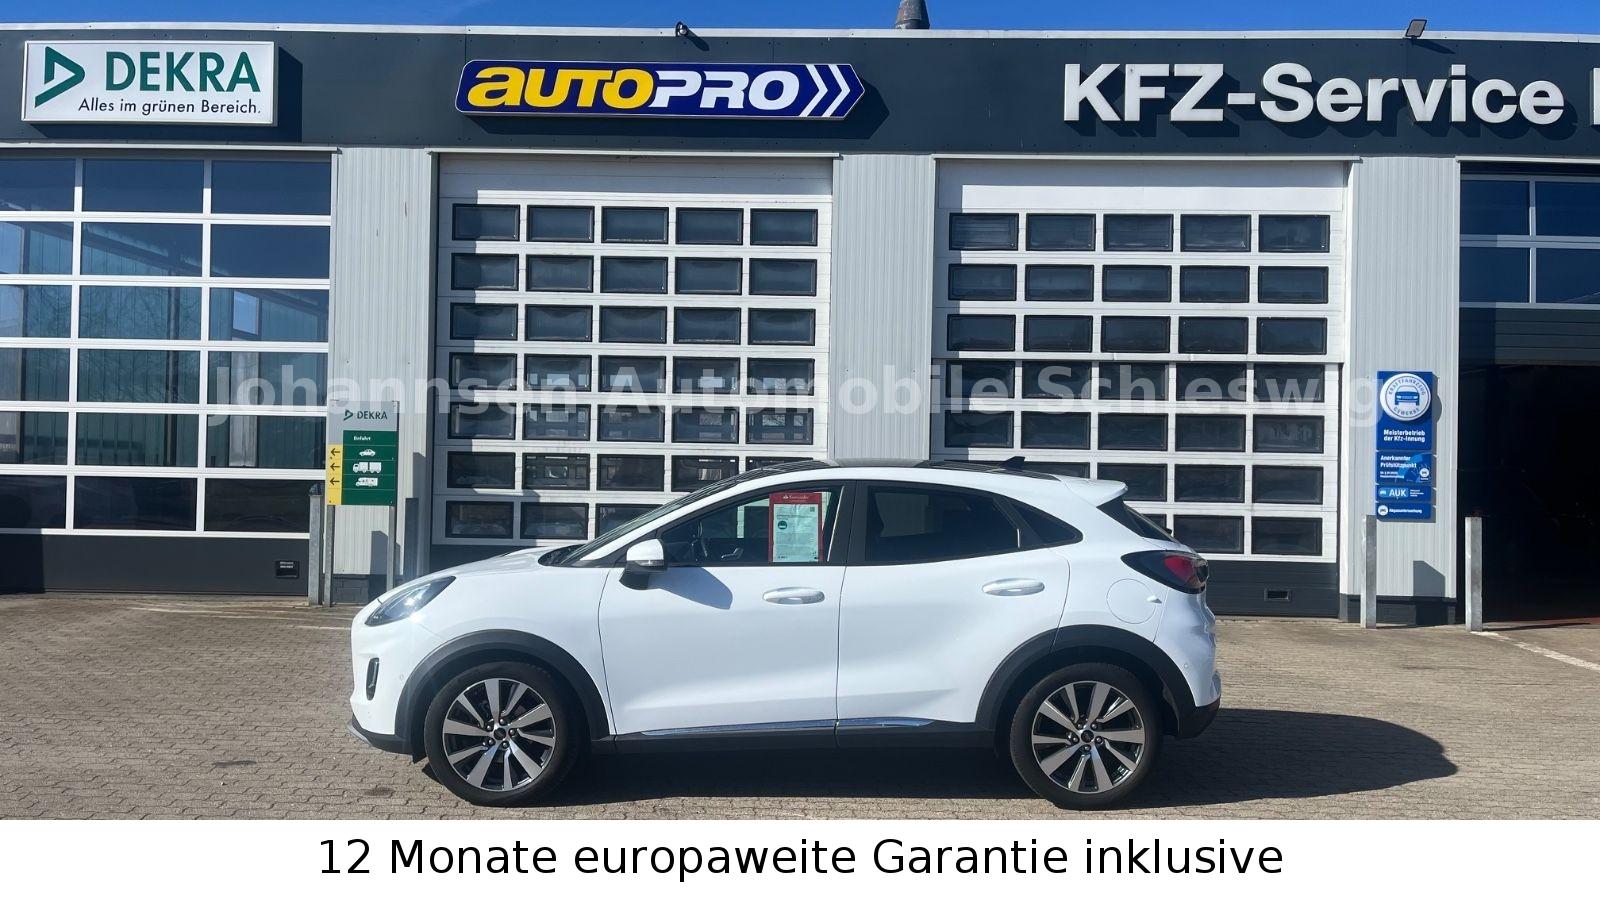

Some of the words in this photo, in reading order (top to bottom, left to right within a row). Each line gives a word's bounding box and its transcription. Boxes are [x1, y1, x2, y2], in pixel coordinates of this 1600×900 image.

[105, 51, 261, 93] DEKRA
[1063, 62, 1565, 125] KFZ-Service
[78, 97, 115, 112] Alles
[119, 97, 137, 112] im
[142, 98, 195, 116] grünen
[201, 98, 262, 114] Bereich.
[356, 410, 388, 420] DEKRA
[1389, 488, 1407, 497] AUK
